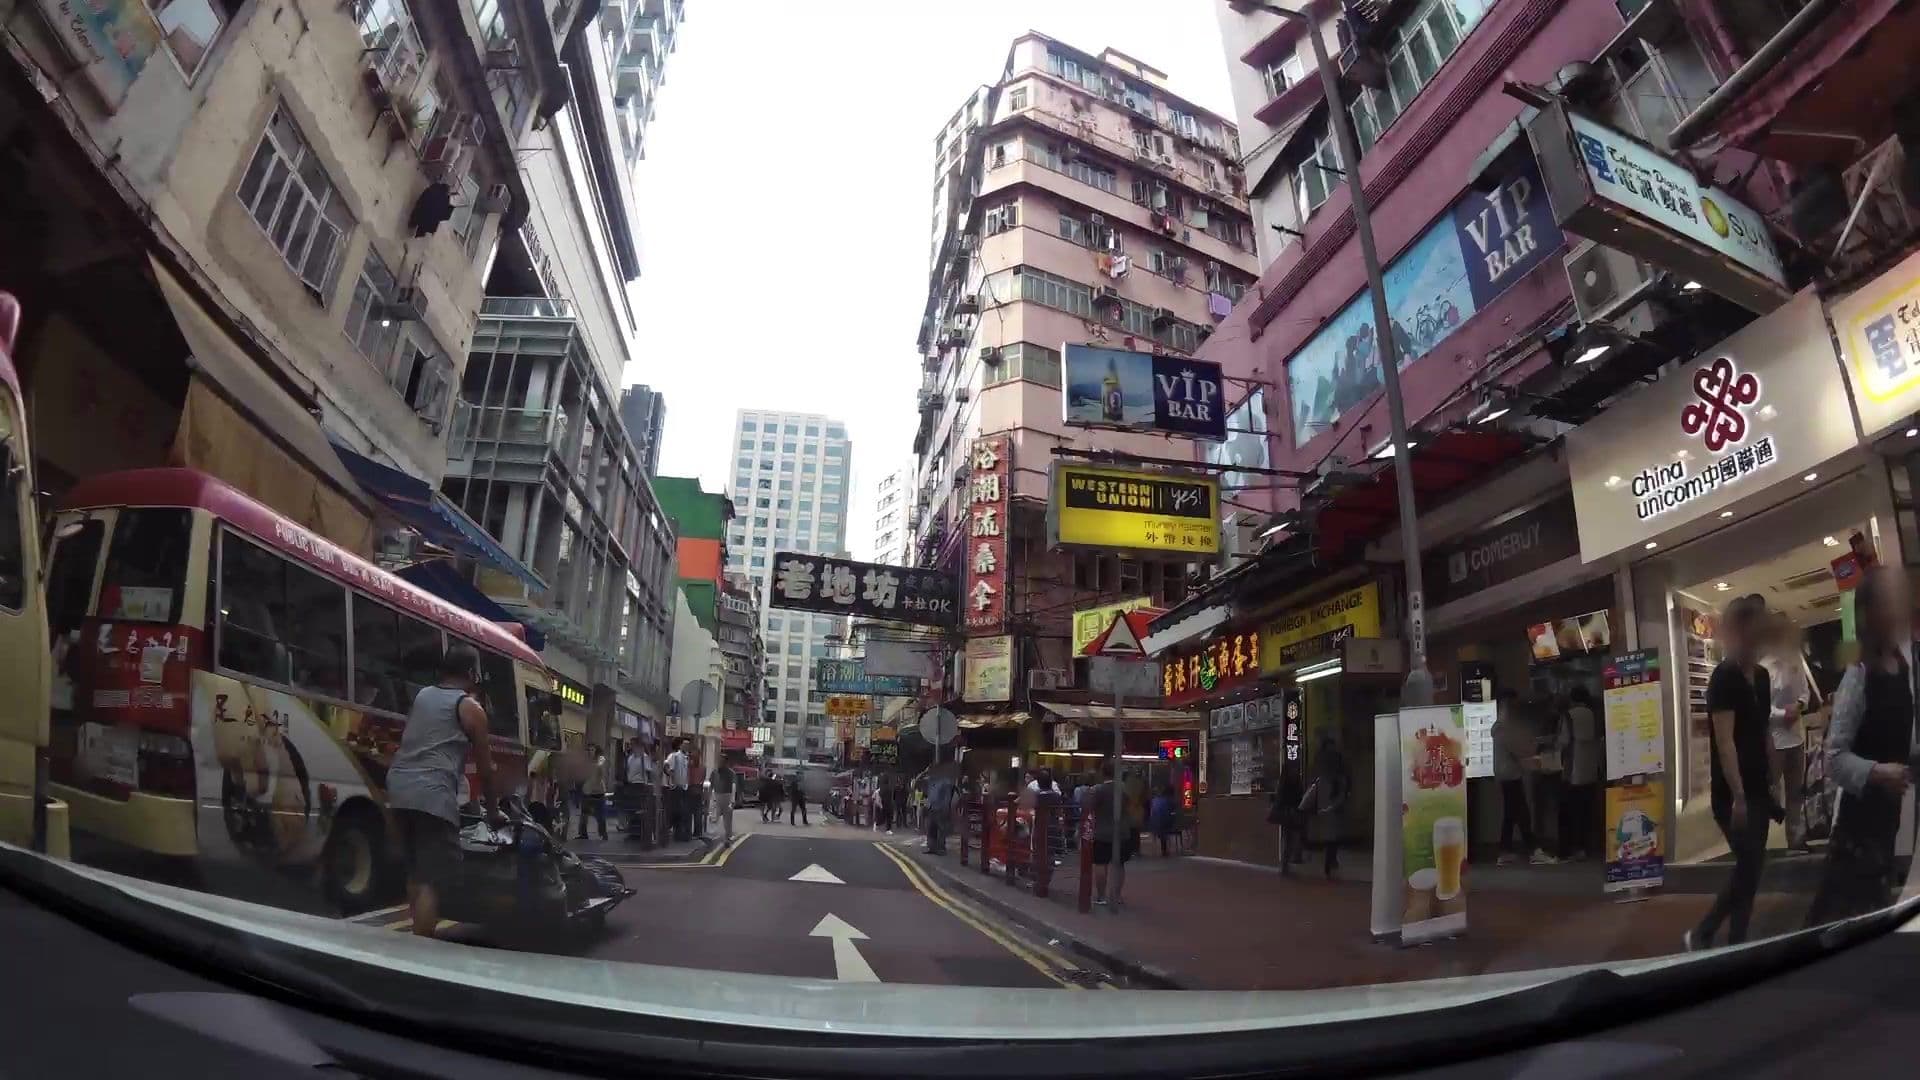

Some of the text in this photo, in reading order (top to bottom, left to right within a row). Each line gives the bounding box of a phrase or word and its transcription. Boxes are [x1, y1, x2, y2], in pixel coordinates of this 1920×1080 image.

[1464, 177, 1531, 255] VIP
[1484, 224, 1538, 282] BAR
[1156, 368, 1217, 404] VIP
[1168, 400, 1212, 421] BAR
[1703, 438, 1774, 487] 中國聯通
[1072, 477, 1202, 511] WESTERN yes!
[1096, 491, 1151, 508] UNION
[1637, 477, 1704, 519] unicom
[275, 518, 309, 552] PUBLIC
[1471, 520, 1540, 570] COMEBUY
